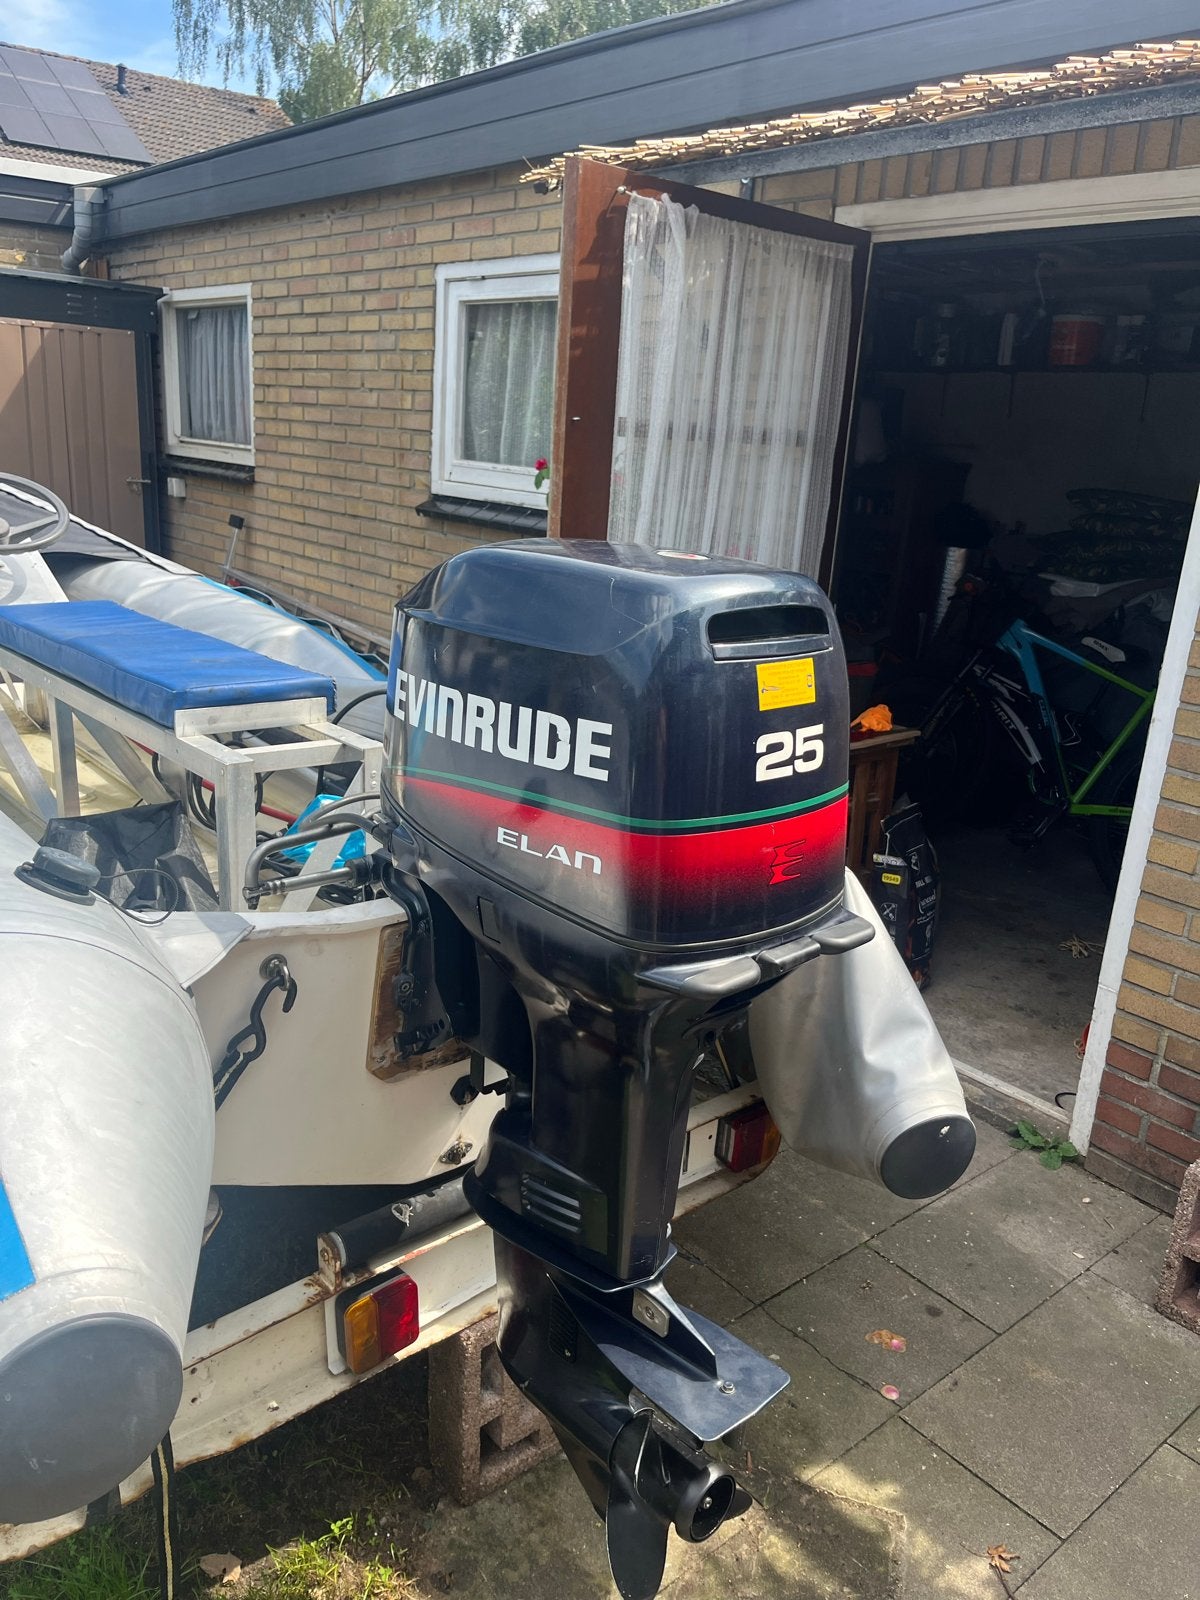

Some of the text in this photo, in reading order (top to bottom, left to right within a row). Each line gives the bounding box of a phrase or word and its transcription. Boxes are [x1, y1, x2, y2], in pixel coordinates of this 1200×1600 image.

[393, 667, 613, 782] EVINRUDE
[755, 723, 824, 783] 25
[496, 826, 602, 875] ELAN
